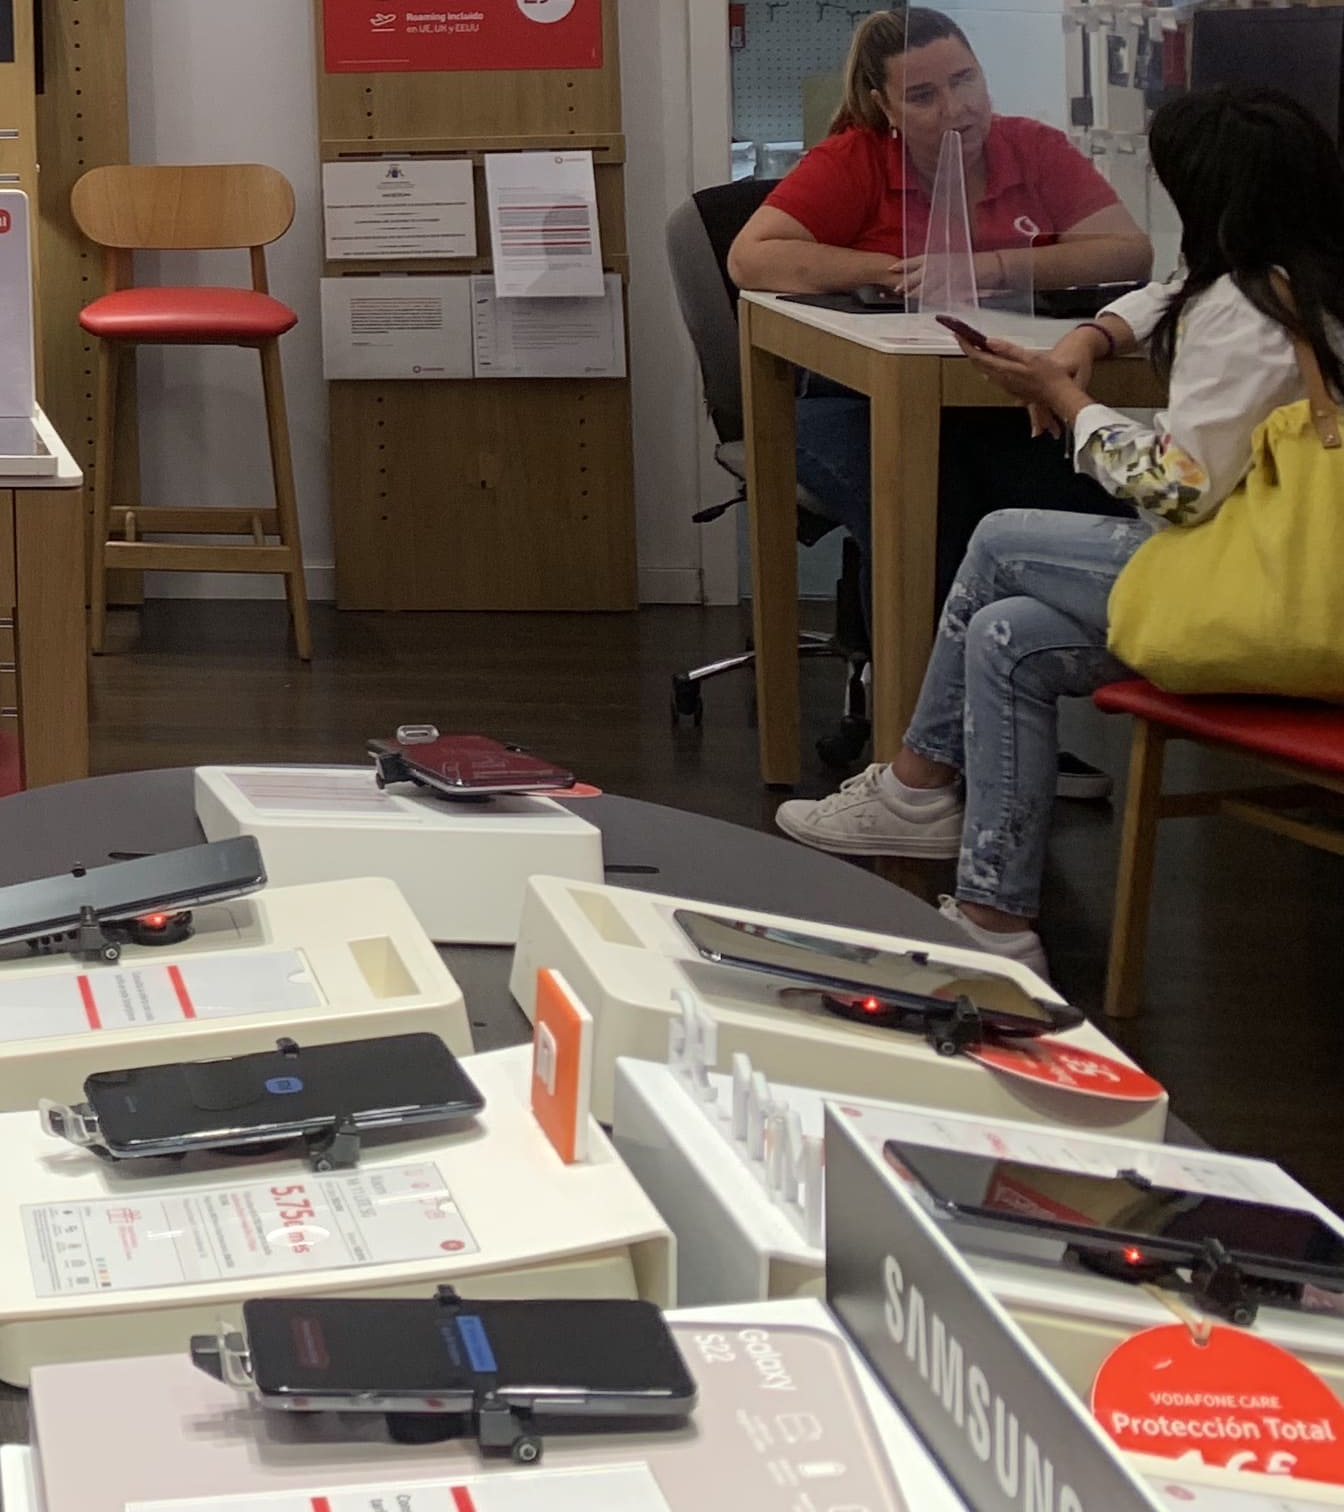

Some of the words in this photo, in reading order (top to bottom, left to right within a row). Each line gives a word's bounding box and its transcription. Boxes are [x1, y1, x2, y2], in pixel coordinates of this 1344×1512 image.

[406, 13, 446, 22] Roaming
[695, 1333, 736, 1363] S22
[739, 1329, 797, 1391] Galaxy
[885, 1255, 1084, 1512] SAMSUN
[1149, 1392, 1237, 1408] VODAFONE
[1239, 1395, 1282, 1409] CARE
[1112, 1412, 1261, 1439] Protección
[1264, 1417, 1336, 1441] Total
